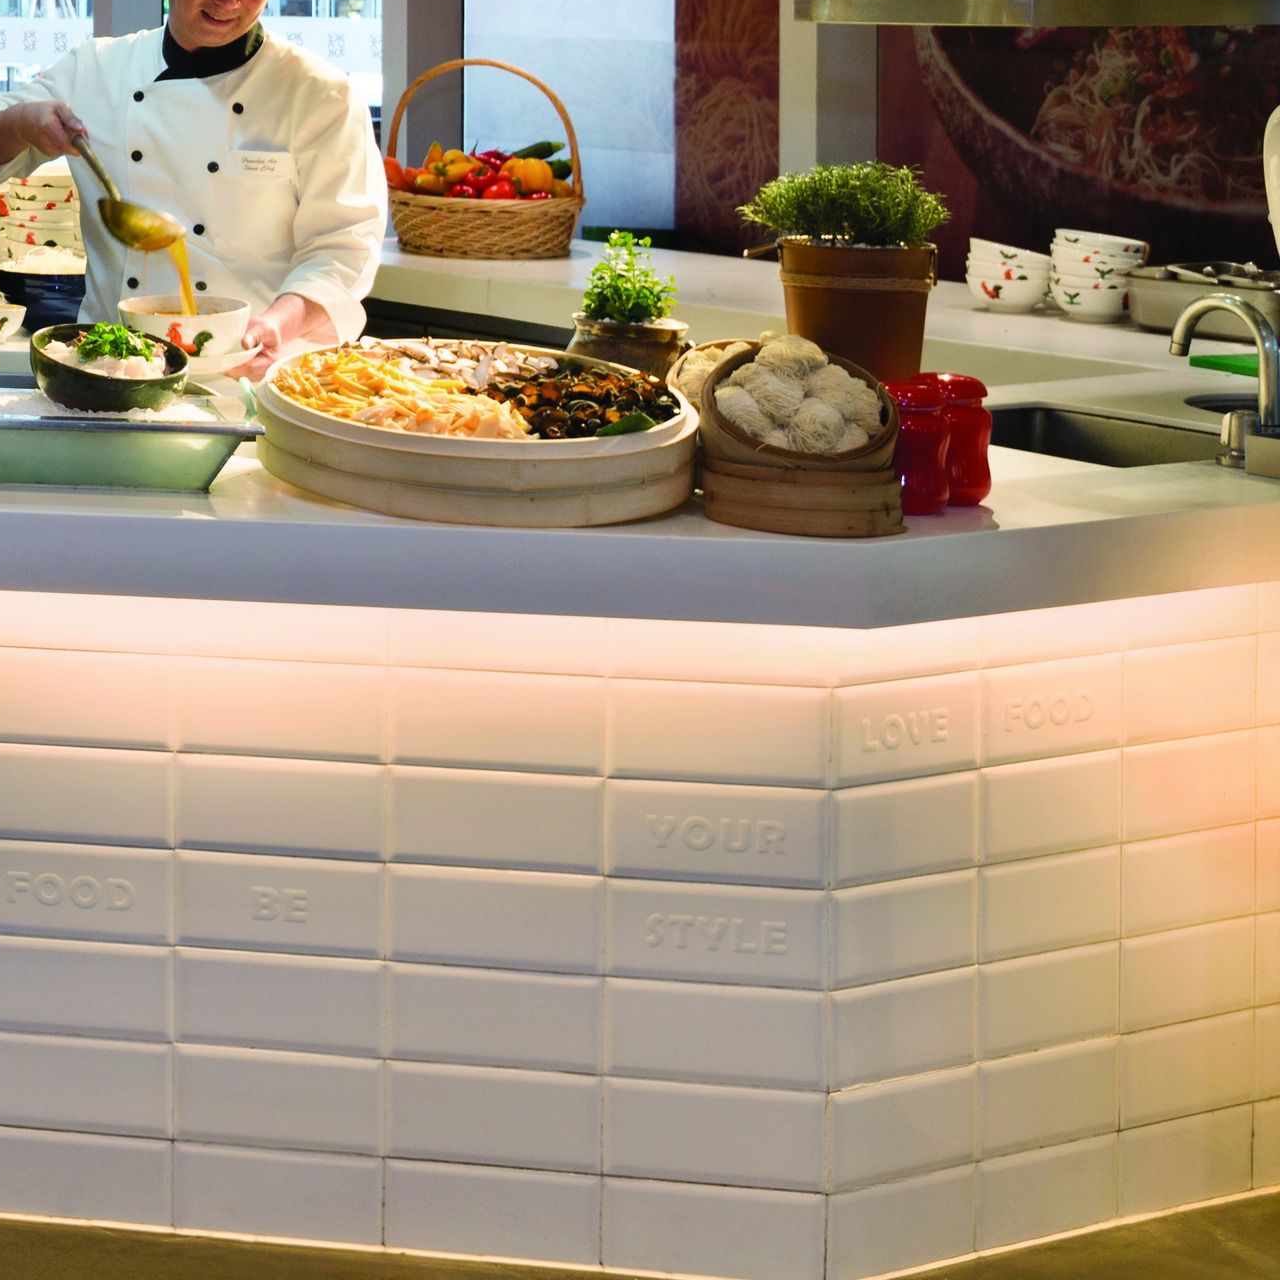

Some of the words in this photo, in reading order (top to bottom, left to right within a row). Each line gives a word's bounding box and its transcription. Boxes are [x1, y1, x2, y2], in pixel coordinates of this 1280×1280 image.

[859, 707, 950, 754] LOVE
[1002, 687, 1096, 734] FOOD
[644, 813, 787, 857] YOUR
[6, 869, 138, 911] FOOD
[249, 885, 310, 923] BE
[643, 911, 789, 958] STYLE
